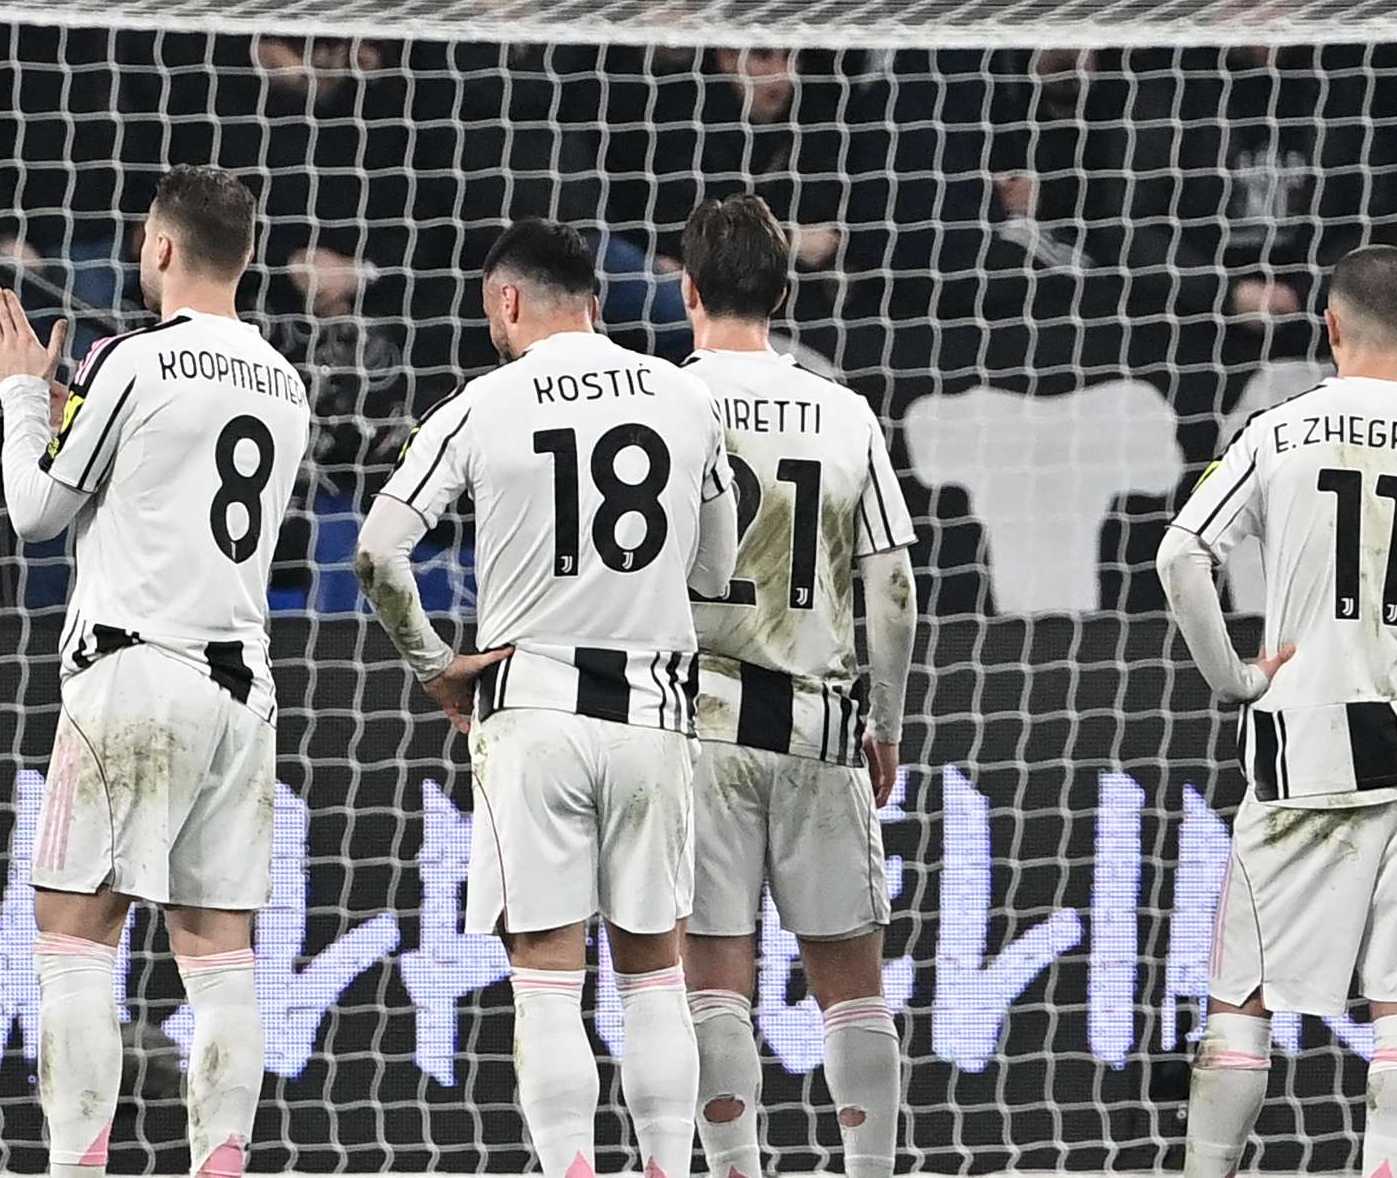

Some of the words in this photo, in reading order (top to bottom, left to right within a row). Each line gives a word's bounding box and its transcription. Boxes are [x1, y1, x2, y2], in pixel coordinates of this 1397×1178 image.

[210, 415, 275, 564] 8
[714, 397, 821, 435] IRETTI
[533, 422, 672, 577] 18
